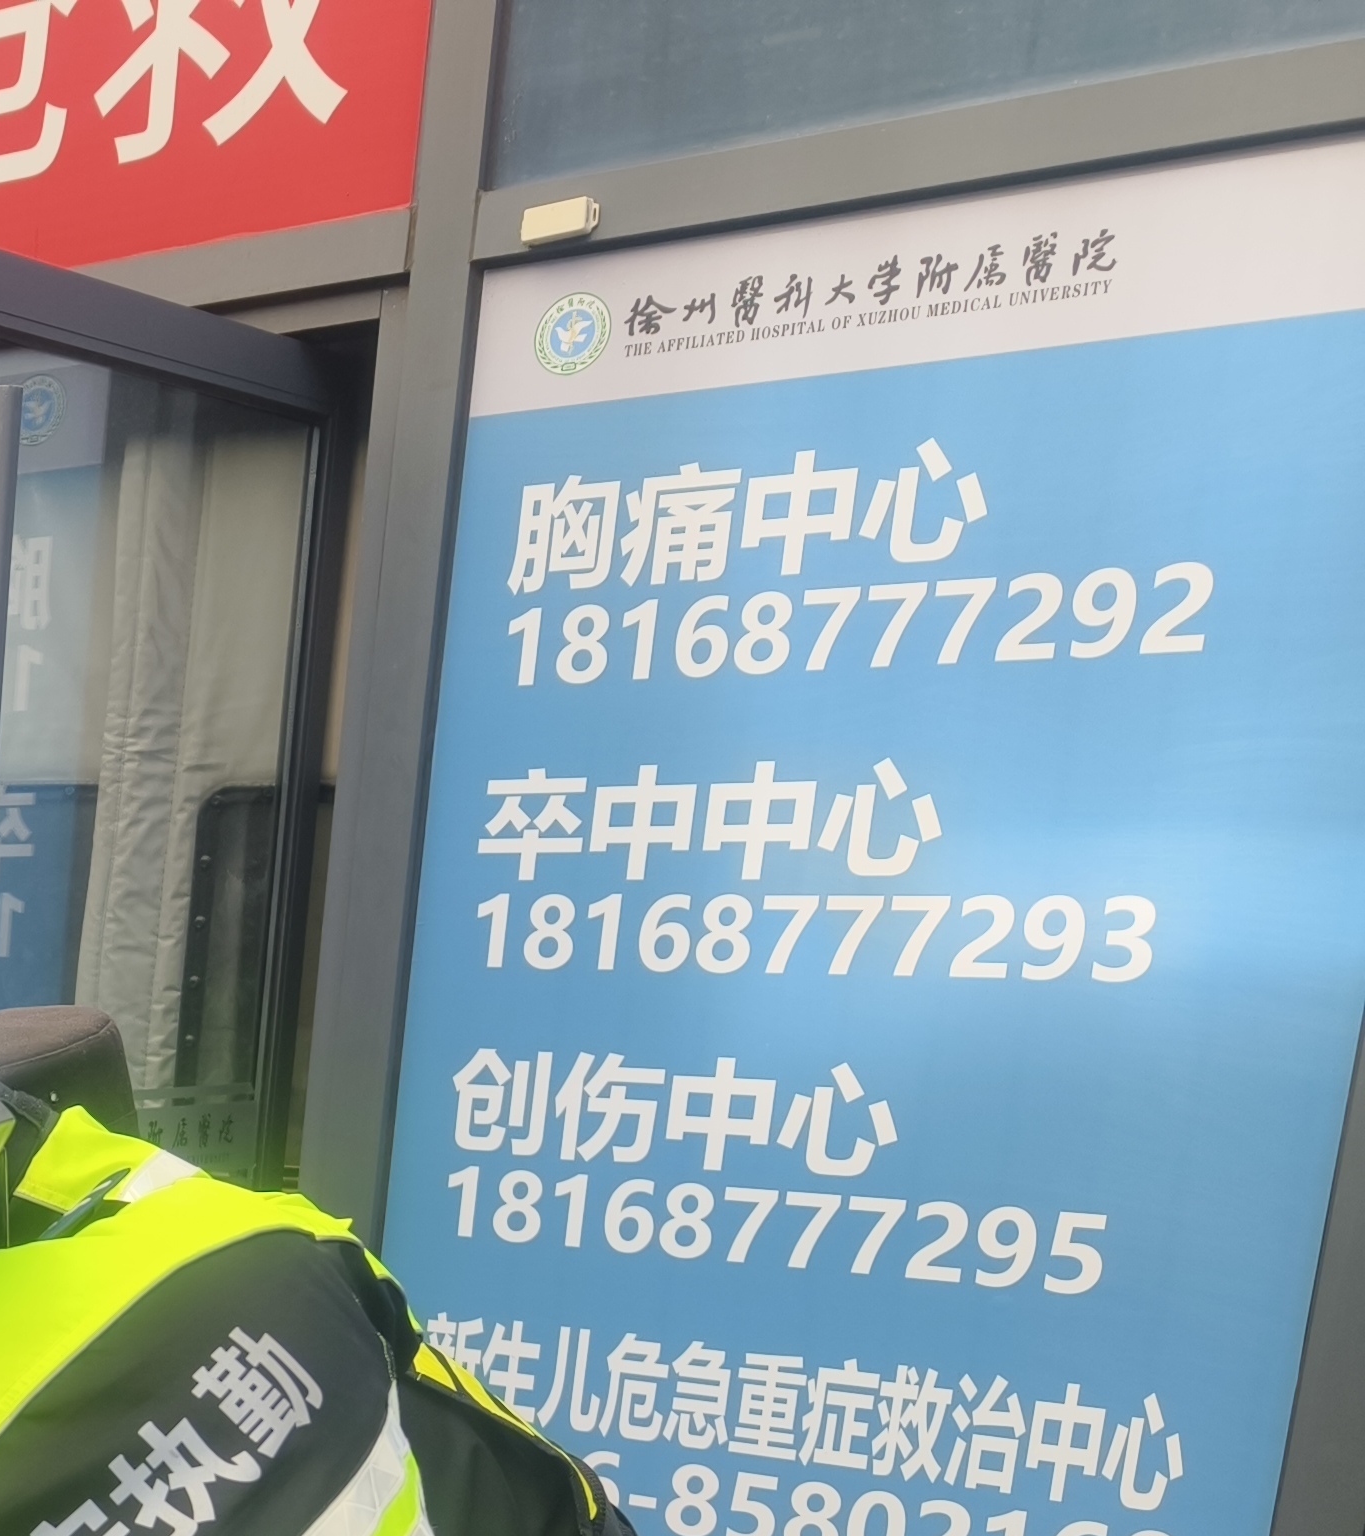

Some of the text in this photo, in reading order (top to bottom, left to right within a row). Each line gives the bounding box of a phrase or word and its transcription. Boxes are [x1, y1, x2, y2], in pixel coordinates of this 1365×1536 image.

[624, 279, 1113, 358] THE AFFILIATED HOSPITAL OF XUZHOU MEDICAL UNIVERSITY
[507, 437, 987, 595] 胸痛中心
[507, 562, 1214, 686] 18168777292
[478, 757, 942, 880] 卒中中心
[476, 893, 1157, 982] 18168777293
[452, 1048, 898, 1177] 创伤中心
[447, 1165, 1107, 1295] 18168777295
